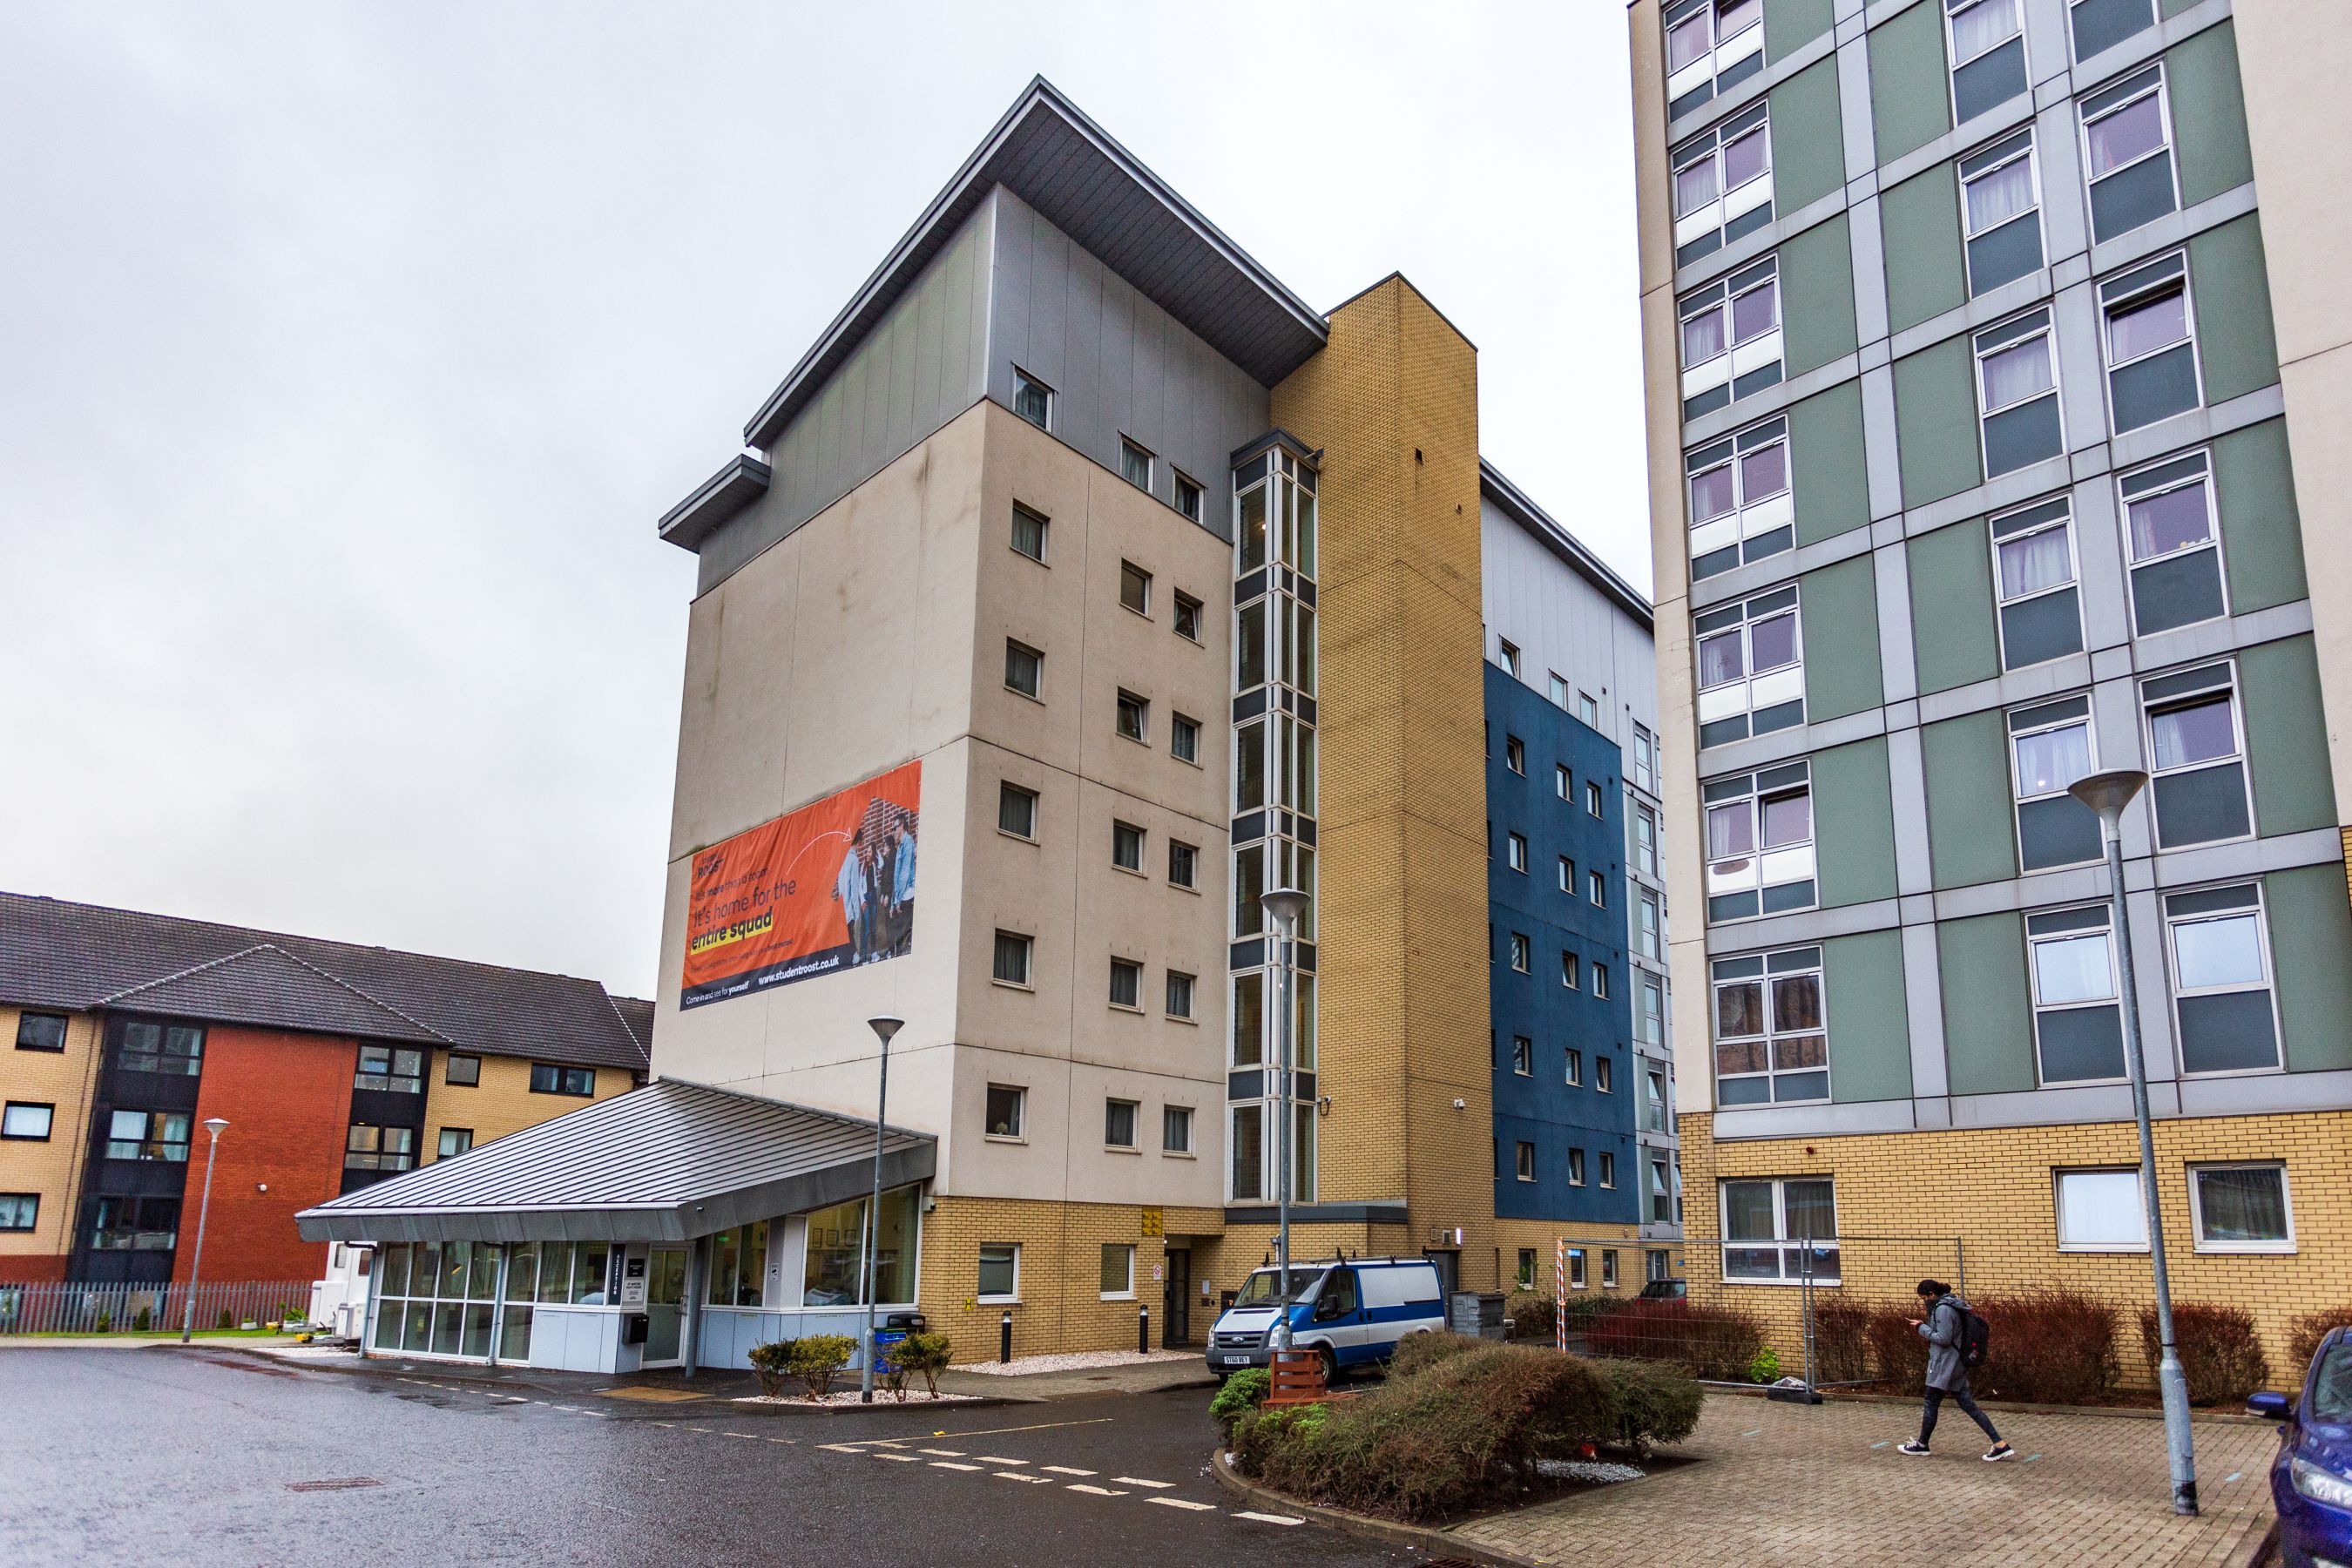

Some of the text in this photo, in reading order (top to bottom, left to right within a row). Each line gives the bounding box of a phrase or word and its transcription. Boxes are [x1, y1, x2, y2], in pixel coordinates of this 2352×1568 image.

[694, 878, 796, 928] It's home for the
[707, 884, 725, 897] more
[691, 906, 774, 950] entire squad
[758, 955, 839, 985] www.studentroost.co.uk
[686, 995, 700, 1004] Come
[705, 990, 713, 999] and
[728, 980, 750, 996] yourself
